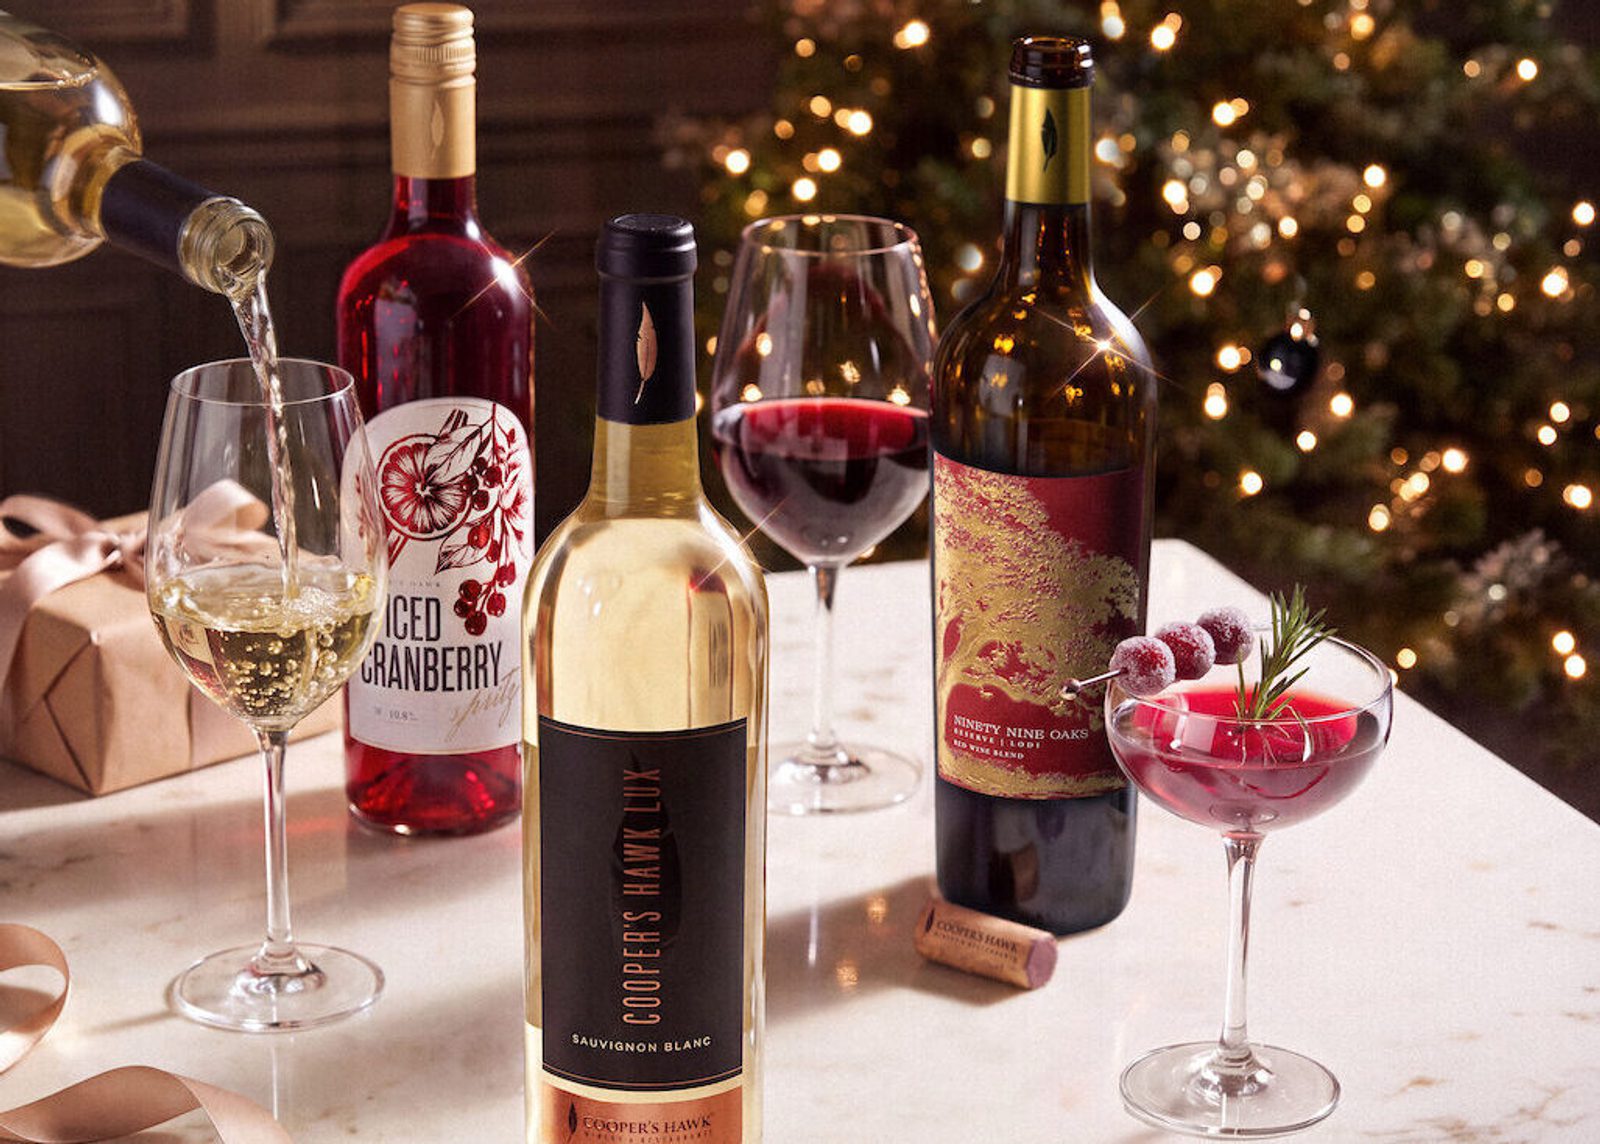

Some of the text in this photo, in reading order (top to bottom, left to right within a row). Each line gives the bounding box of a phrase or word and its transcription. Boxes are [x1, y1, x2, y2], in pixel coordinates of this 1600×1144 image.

[386, 594, 441, 642] ICED
[361, 641, 503, 692] CRANBERRY
[953, 715, 1089, 740] NINETY NINE OAKS
[953, 727, 1041, 749] RESERVE LODI
[953, 738, 1025, 760] RED WINE BLEND
[622, 769, 662, 1026] COOPER'S HAWK LUX
[985, 934, 1018, 953] HAWK
[572, 1034, 712, 1052] SAUVIGNON BLANC
[583, 1113, 712, 1135] COOPER'S HAWK
